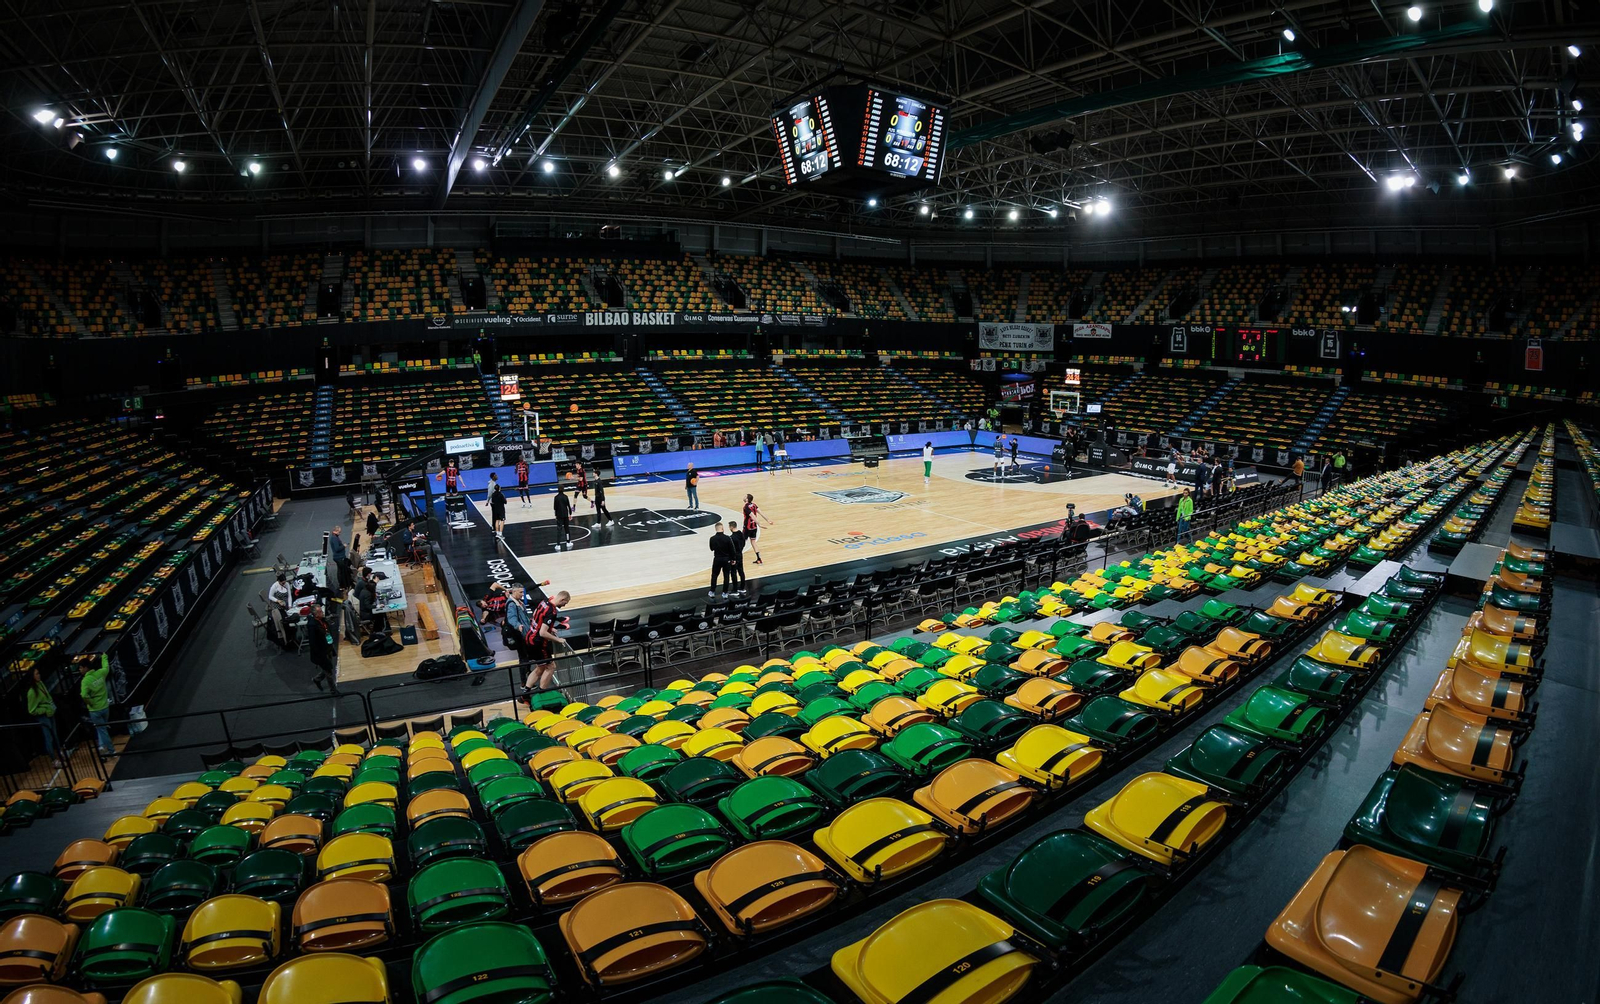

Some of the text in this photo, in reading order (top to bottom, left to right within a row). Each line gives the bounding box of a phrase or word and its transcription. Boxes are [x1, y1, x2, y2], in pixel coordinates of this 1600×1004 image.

[809, 118, 815, 130] 0
[891, 114, 898, 126] 0
[792, 126, 798, 137] 0
[914, 121, 922, 132] 0
[801, 155, 826, 174] 68:12
[884, 152, 918, 171] 68:12
[484, 315, 511, 324] vueling
[586, 312, 676, 325] BILBAO BASKET
[1327, 339, 1333, 347] 15
[504, 384, 518, 394] 24
[125, 399, 130, 408] C
[647, 512, 711, 524] Occident
[828, 535, 871, 544] liga
[844, 532, 927, 549] endesa
[1180, 804, 1191, 813] 118
[1088, 875, 1101, 885] 119
[952, 962, 971, 974] 120
